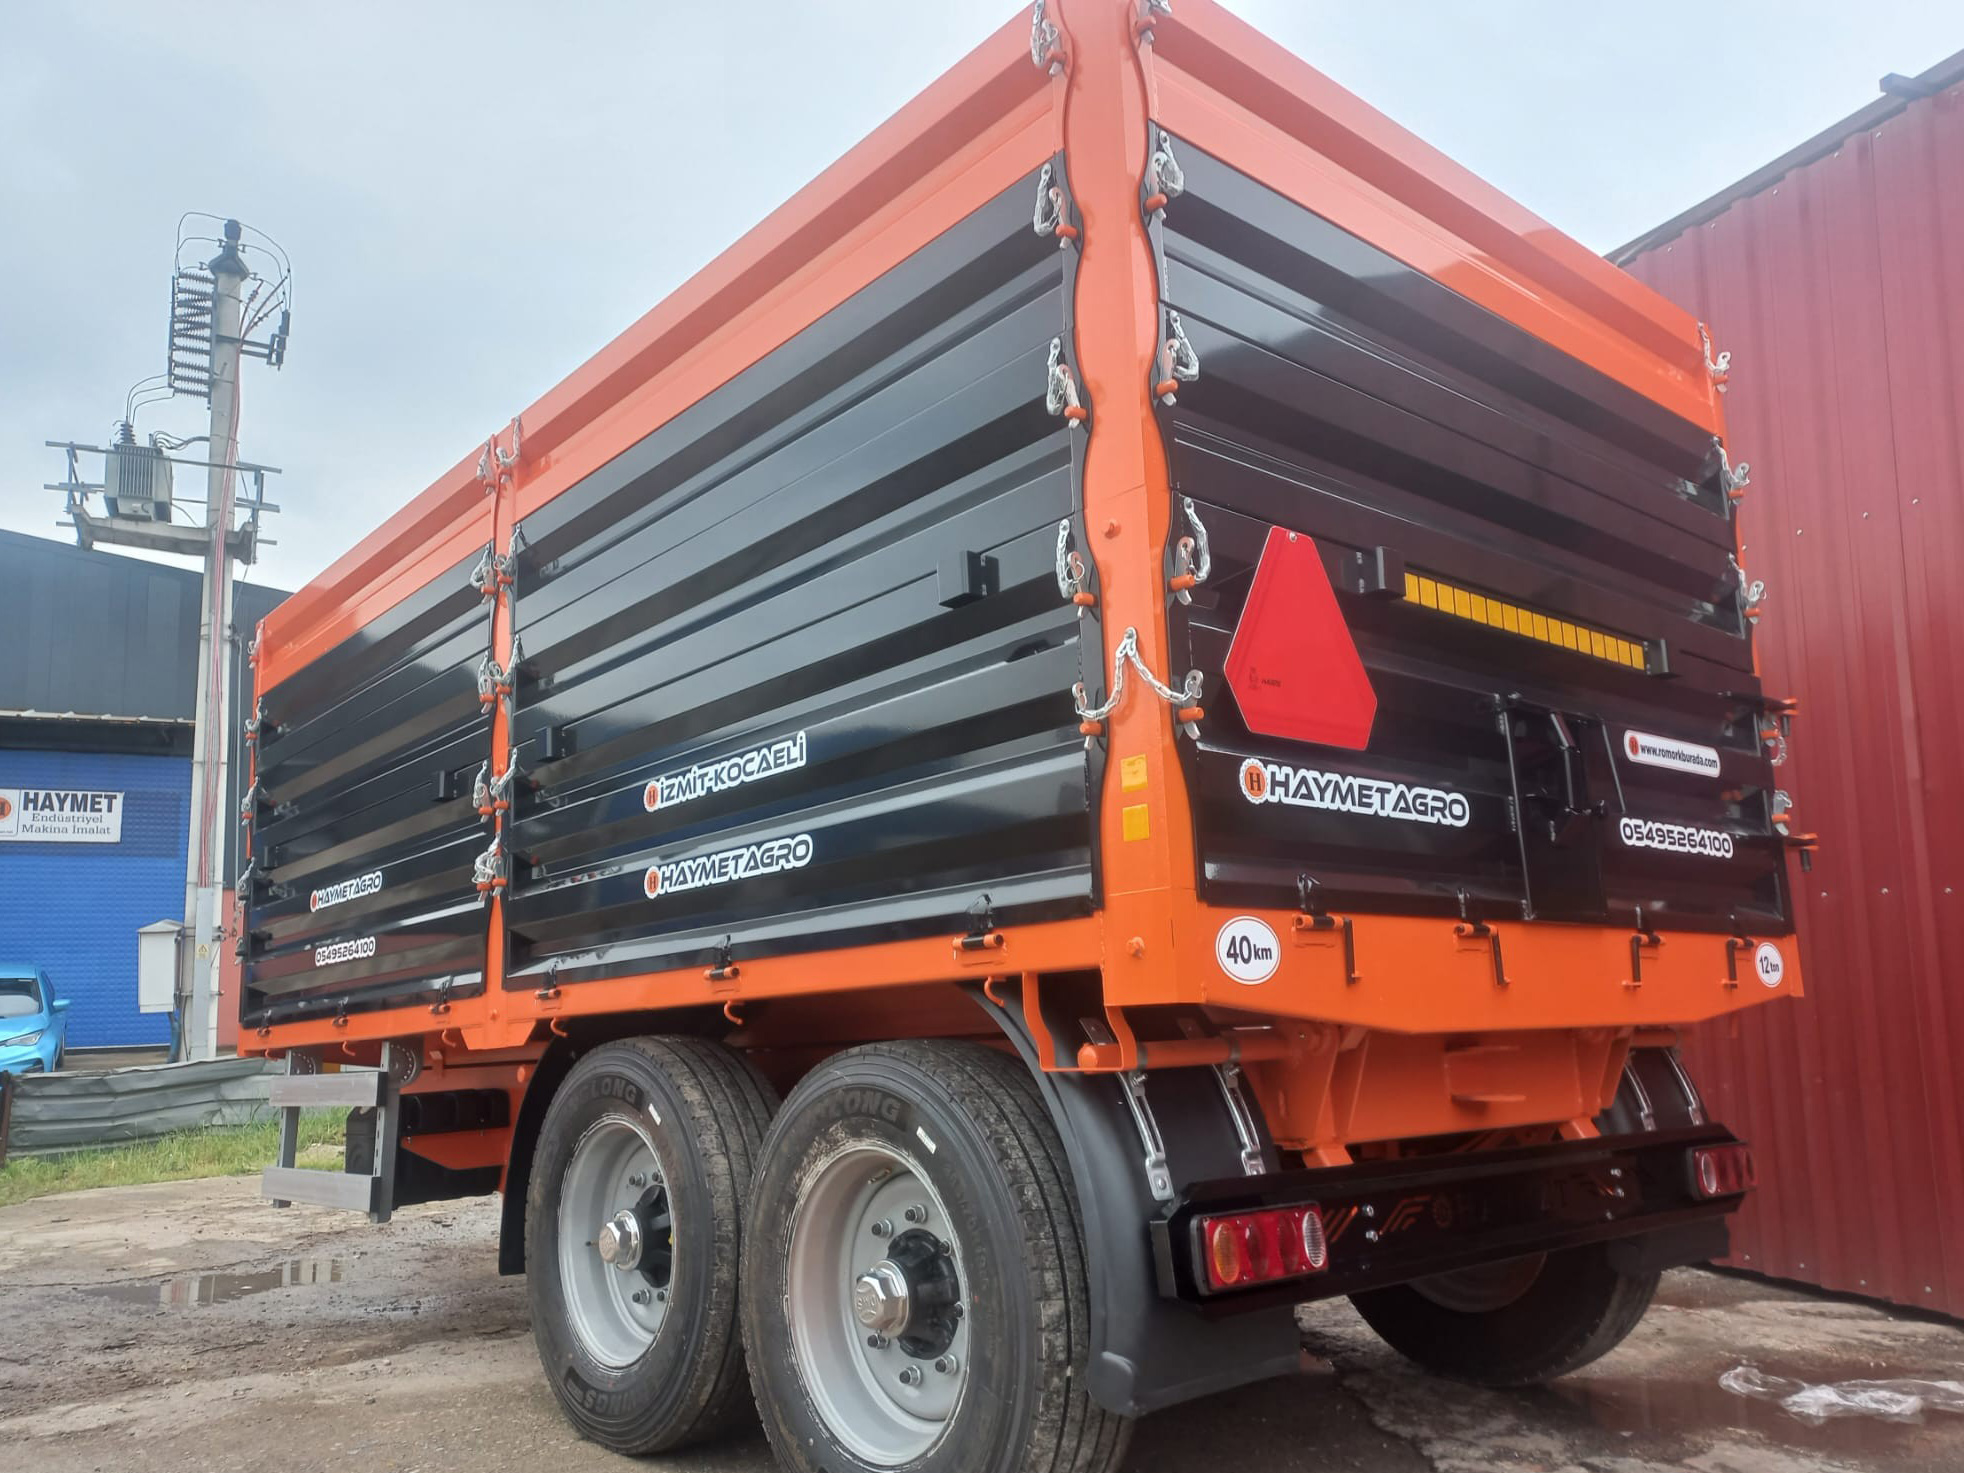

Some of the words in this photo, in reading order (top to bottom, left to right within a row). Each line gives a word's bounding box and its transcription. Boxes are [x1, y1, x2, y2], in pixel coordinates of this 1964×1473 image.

[660, 734, 804, 804] İZMİT-KOCAELİ
[1640, 744, 1718, 769] www.romorkburada.com
[23, 791, 117, 813] HAYMET
[1269, 771, 1467, 822] HAYMETAGRO
[22, 824, 68, 834] Makina
[72, 824, 111, 835] İmalat
[32, 812, 103, 825] Endüstriyel
[1622, 822, 1731, 854] 05495264100
[660, 838, 811, 890] HAYMETAGRO
[317, 874, 382, 906] HAYMETAGRO
[315, 940, 375, 963] 05495264100
